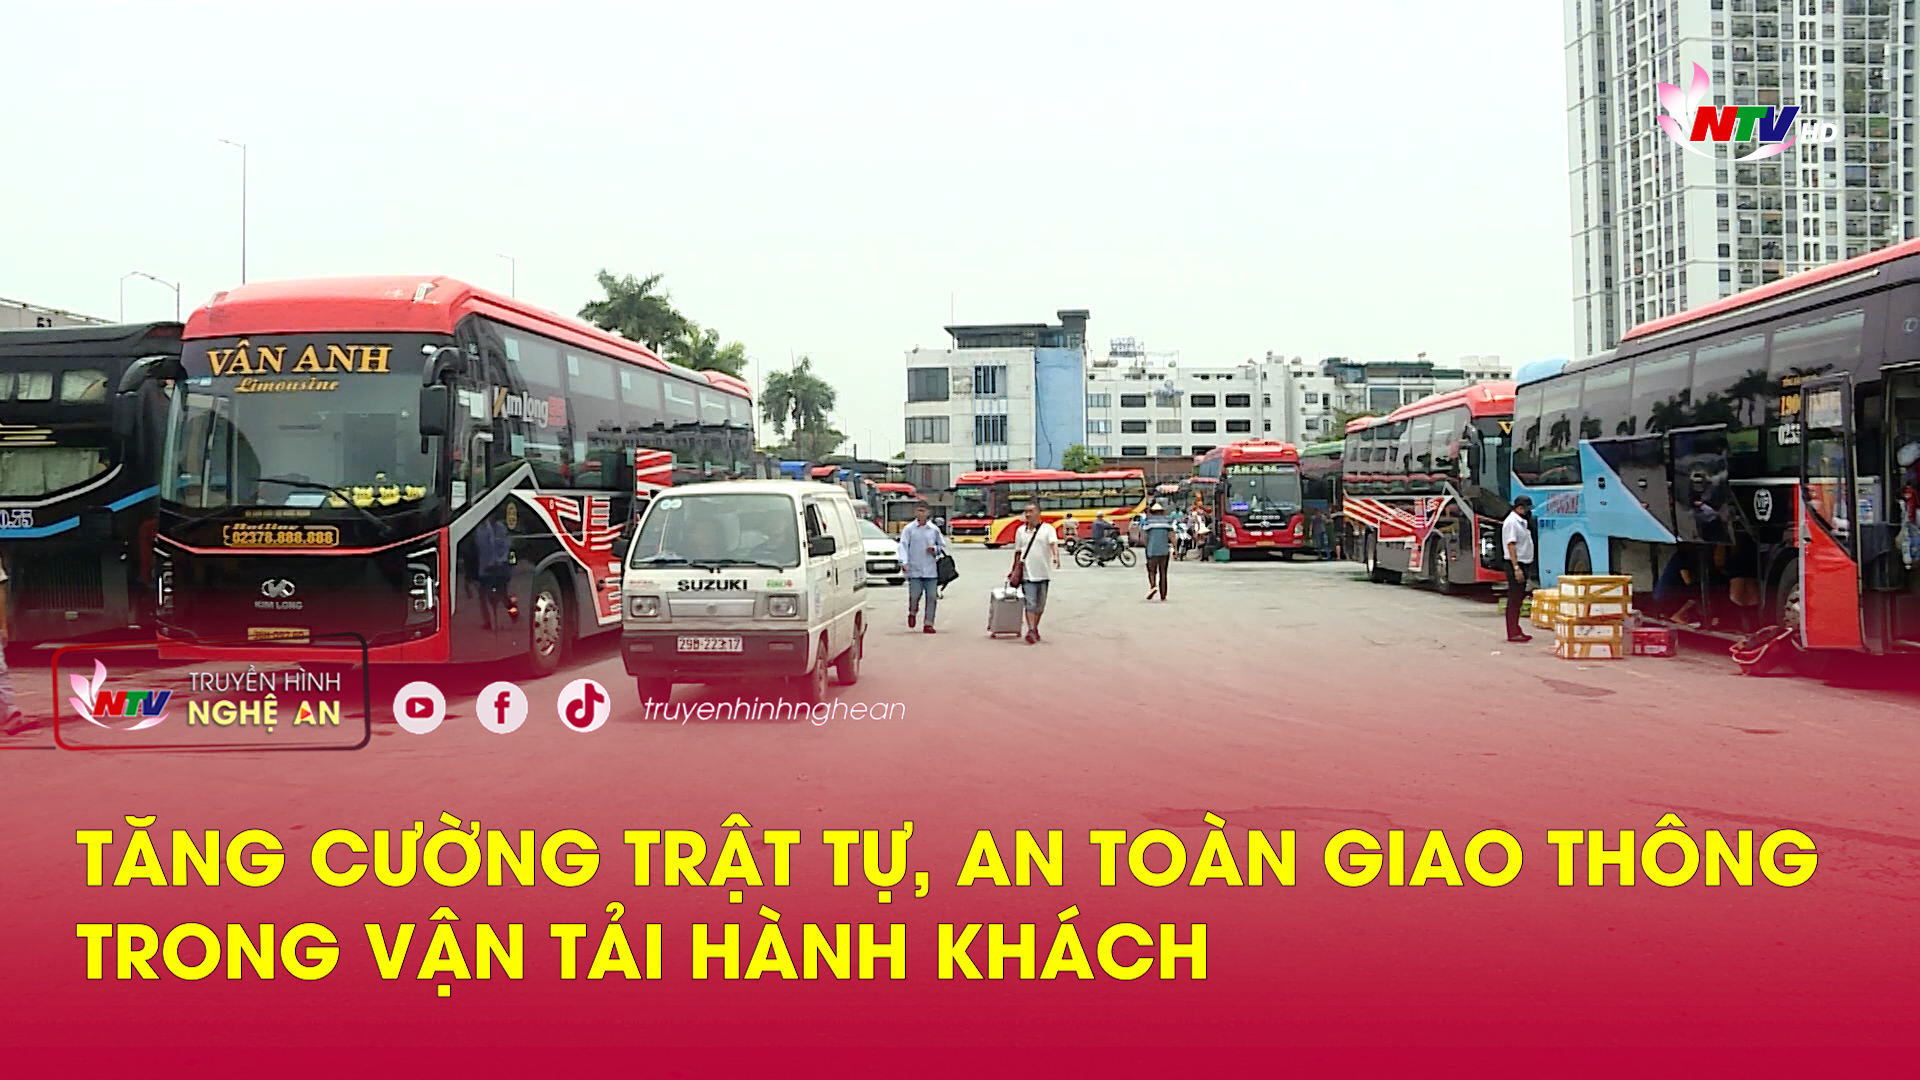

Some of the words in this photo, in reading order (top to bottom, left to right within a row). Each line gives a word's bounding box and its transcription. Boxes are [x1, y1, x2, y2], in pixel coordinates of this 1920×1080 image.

[207, 338, 288, 376] VÂN
[291, 343, 393, 373] ANH
[234, 376, 340, 394] Limousine
[232, 531, 334, 545] 02378.888.888
[677, 579, 748, 591] SUZUKI
[254, 601, 274, 610] KIM
[275, 601, 304, 610] LONG
